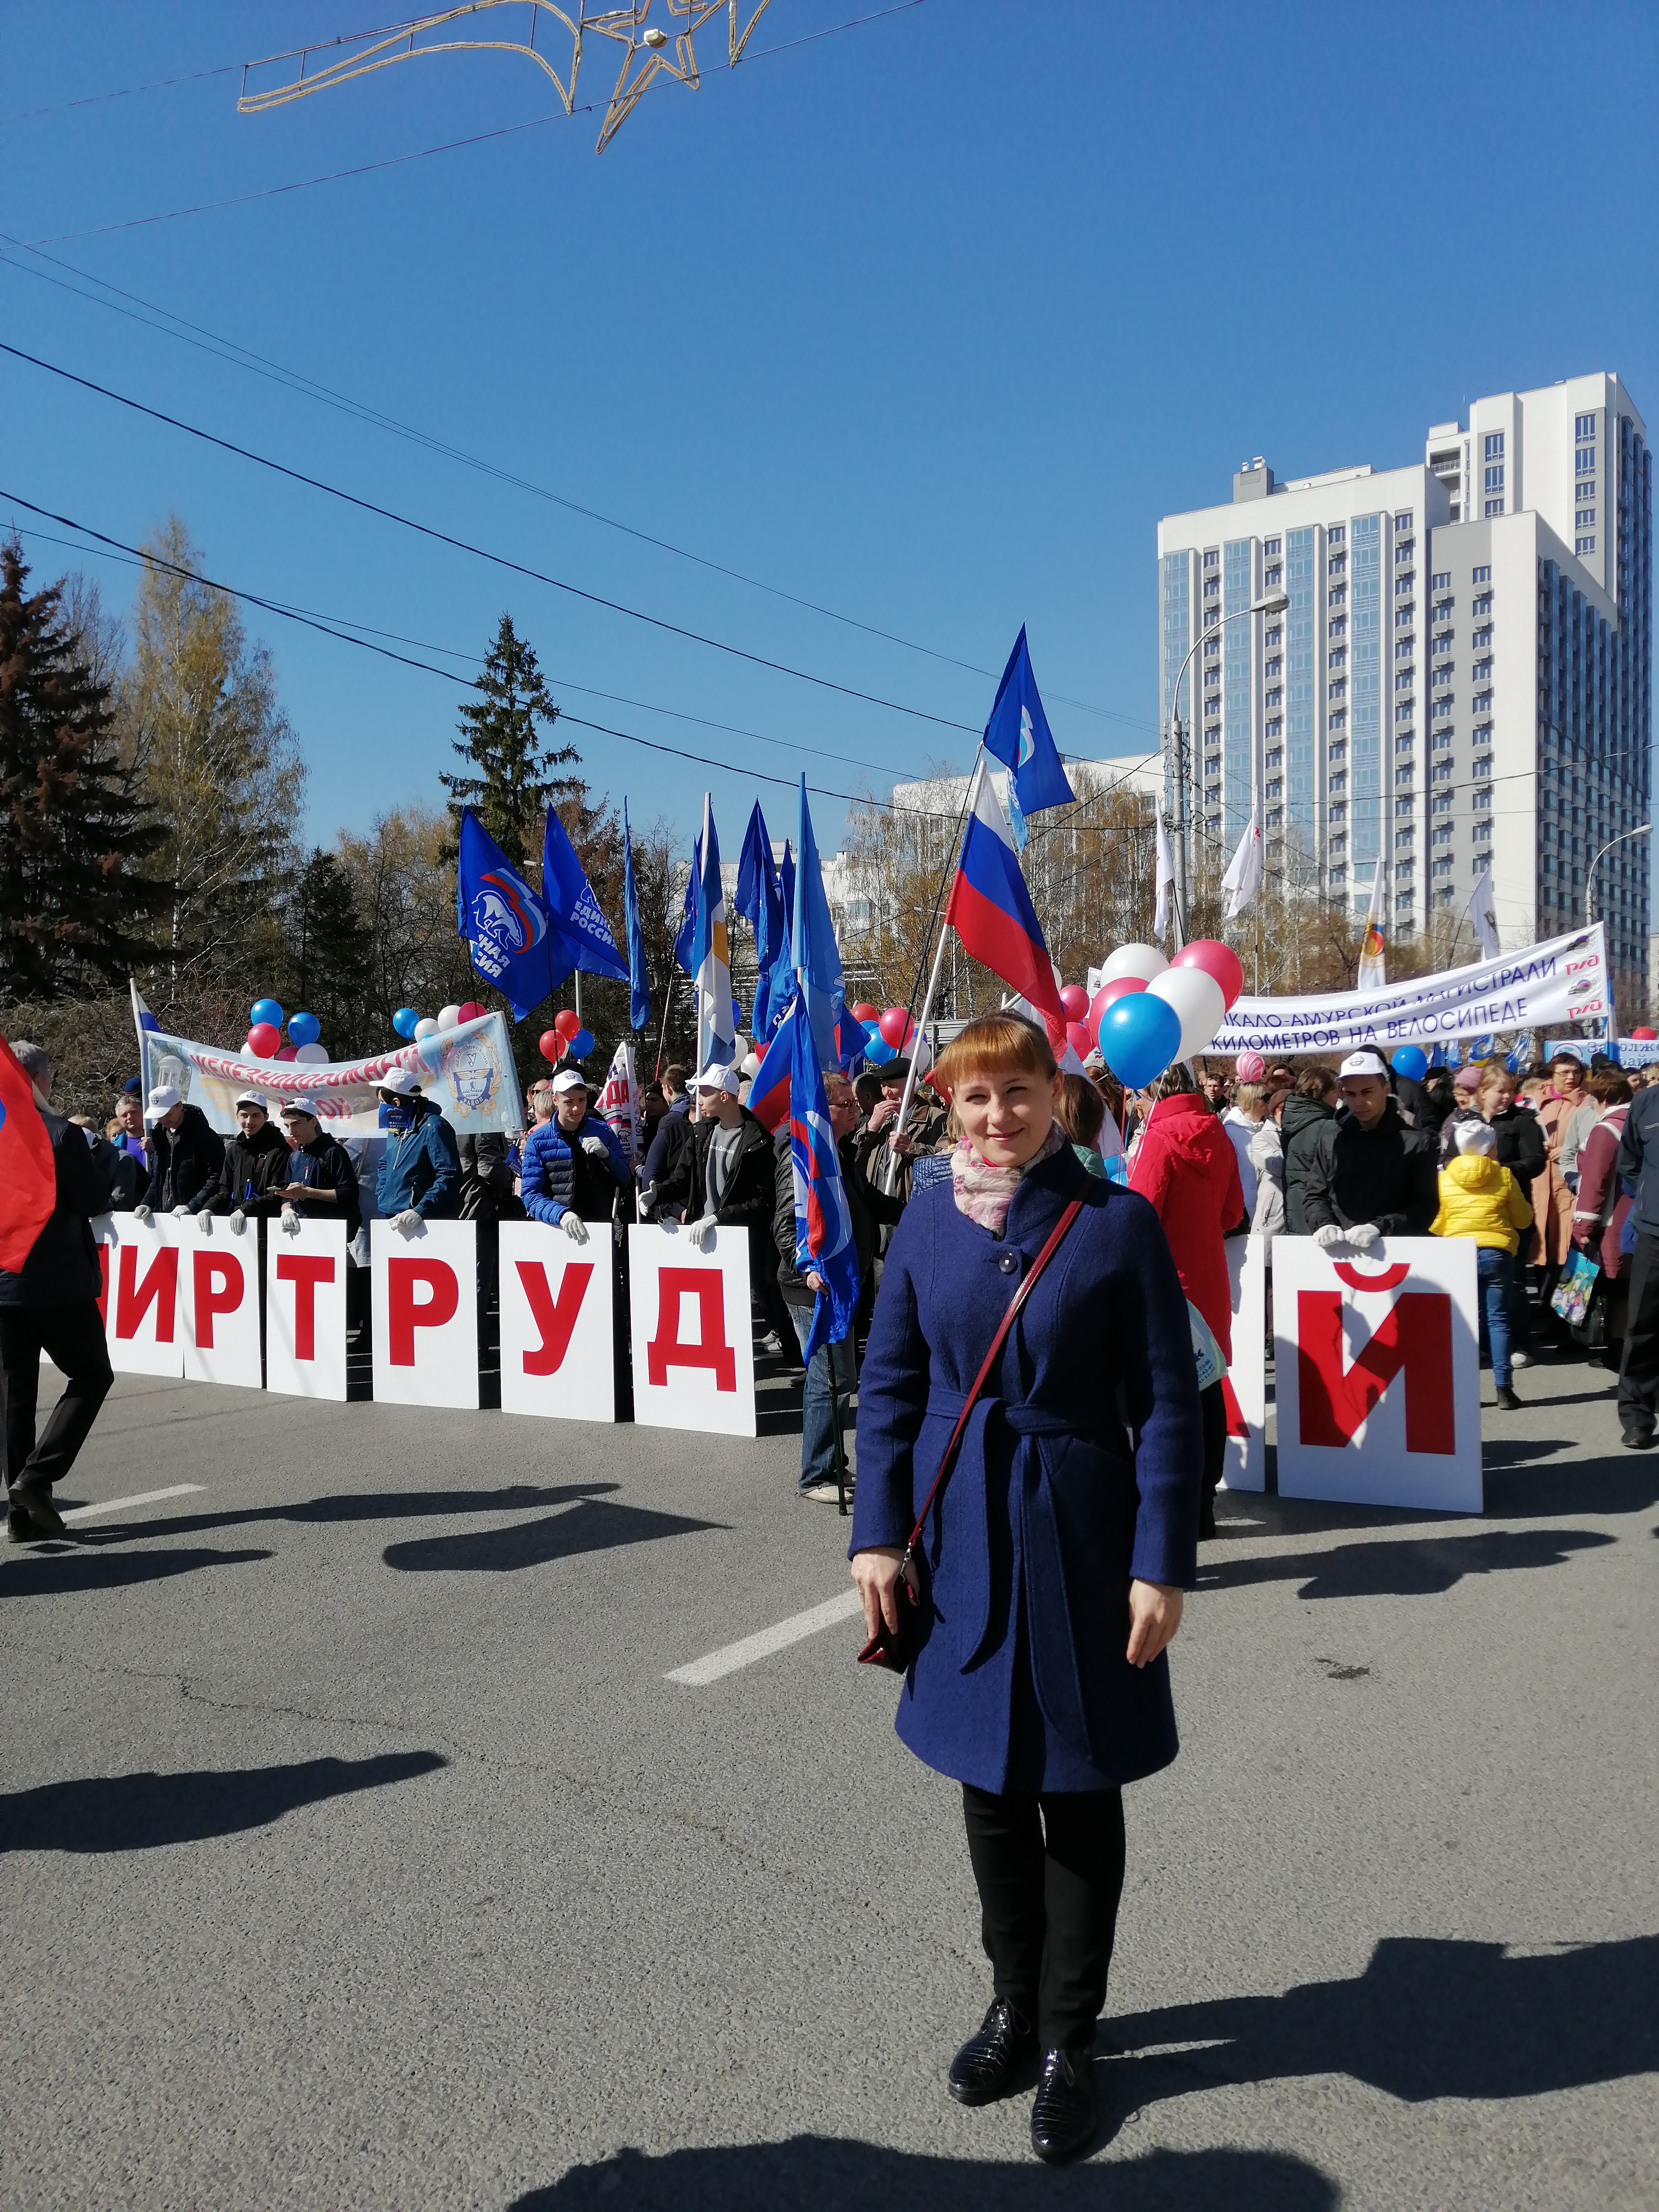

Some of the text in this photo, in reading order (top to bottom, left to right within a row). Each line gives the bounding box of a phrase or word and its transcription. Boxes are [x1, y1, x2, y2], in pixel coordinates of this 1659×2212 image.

[1211, 997, 1528, 1051] КИЛОМЕТРОВ НА ВЕЛОСИПЕДЕ
